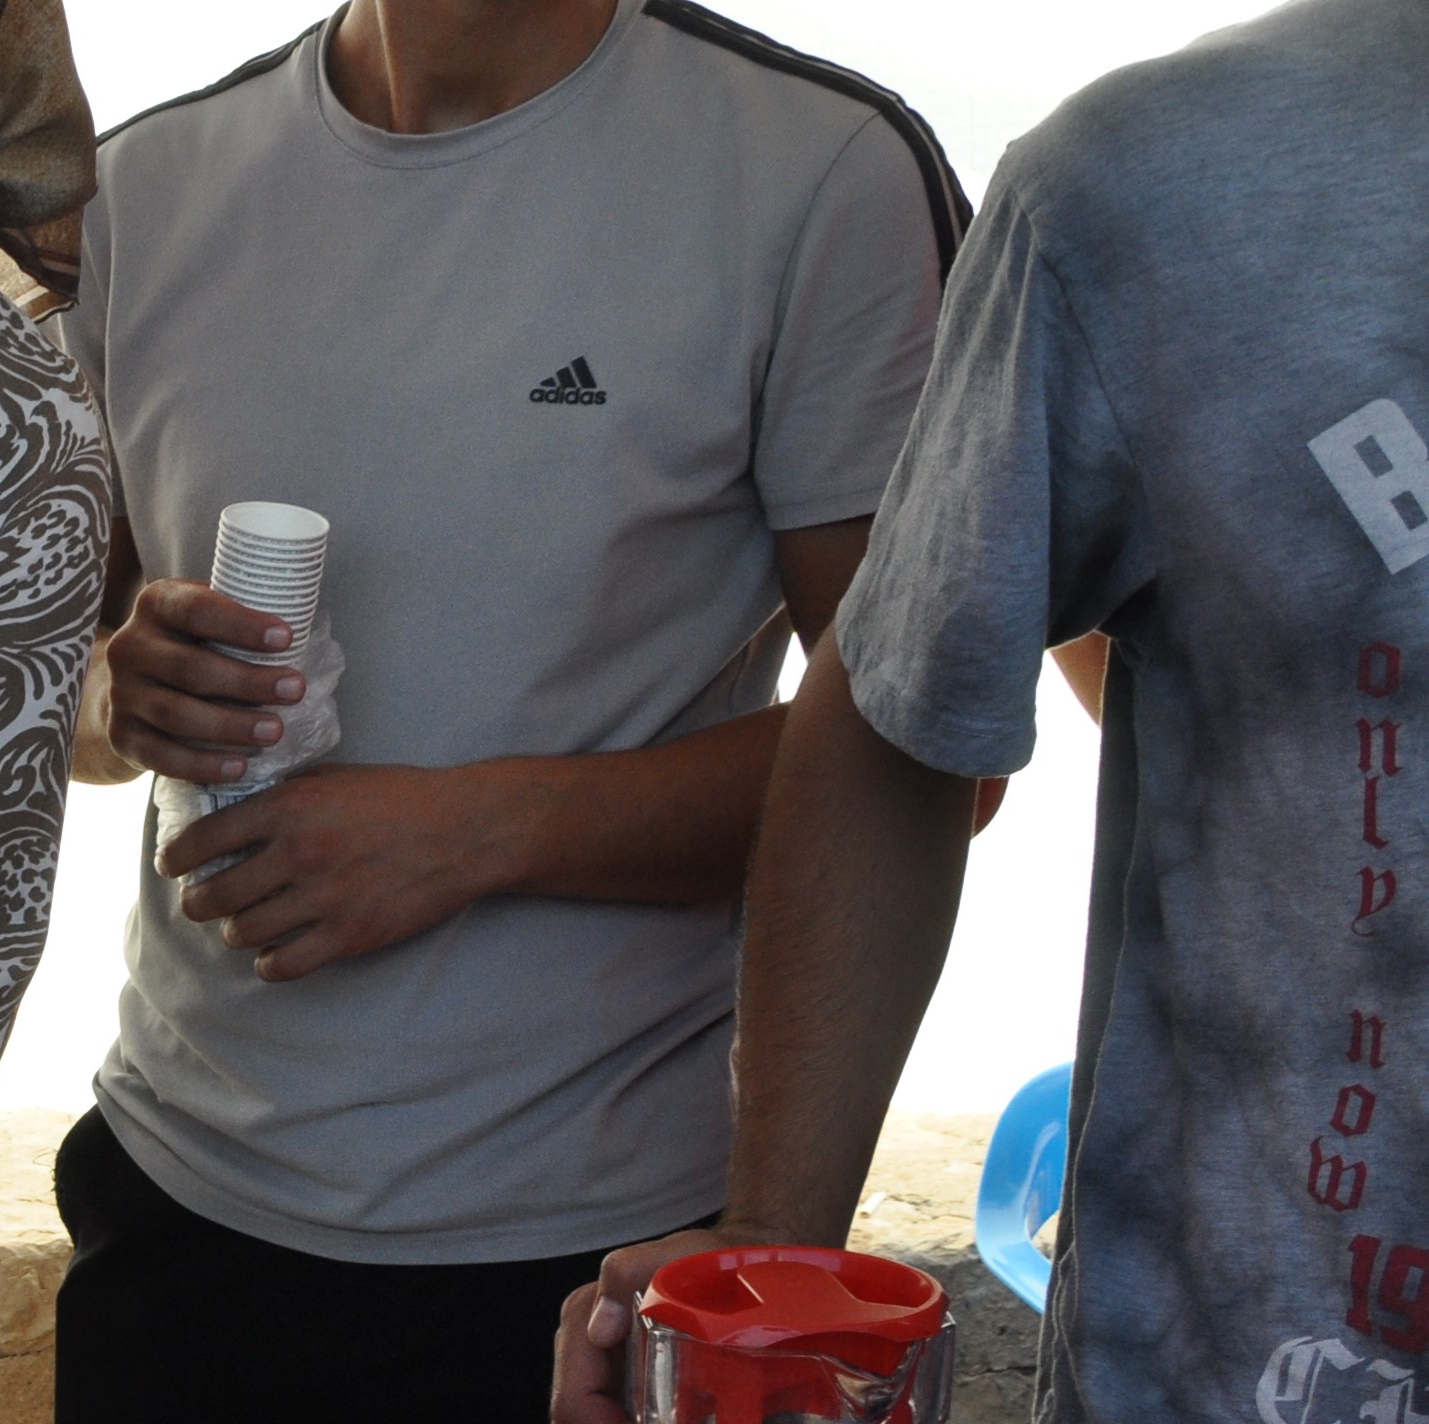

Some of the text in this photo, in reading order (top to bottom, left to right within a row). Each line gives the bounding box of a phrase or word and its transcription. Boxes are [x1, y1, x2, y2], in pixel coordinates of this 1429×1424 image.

[529, 386, 607, 406] adidas
[1306, 640, 1403, 1213] only now
